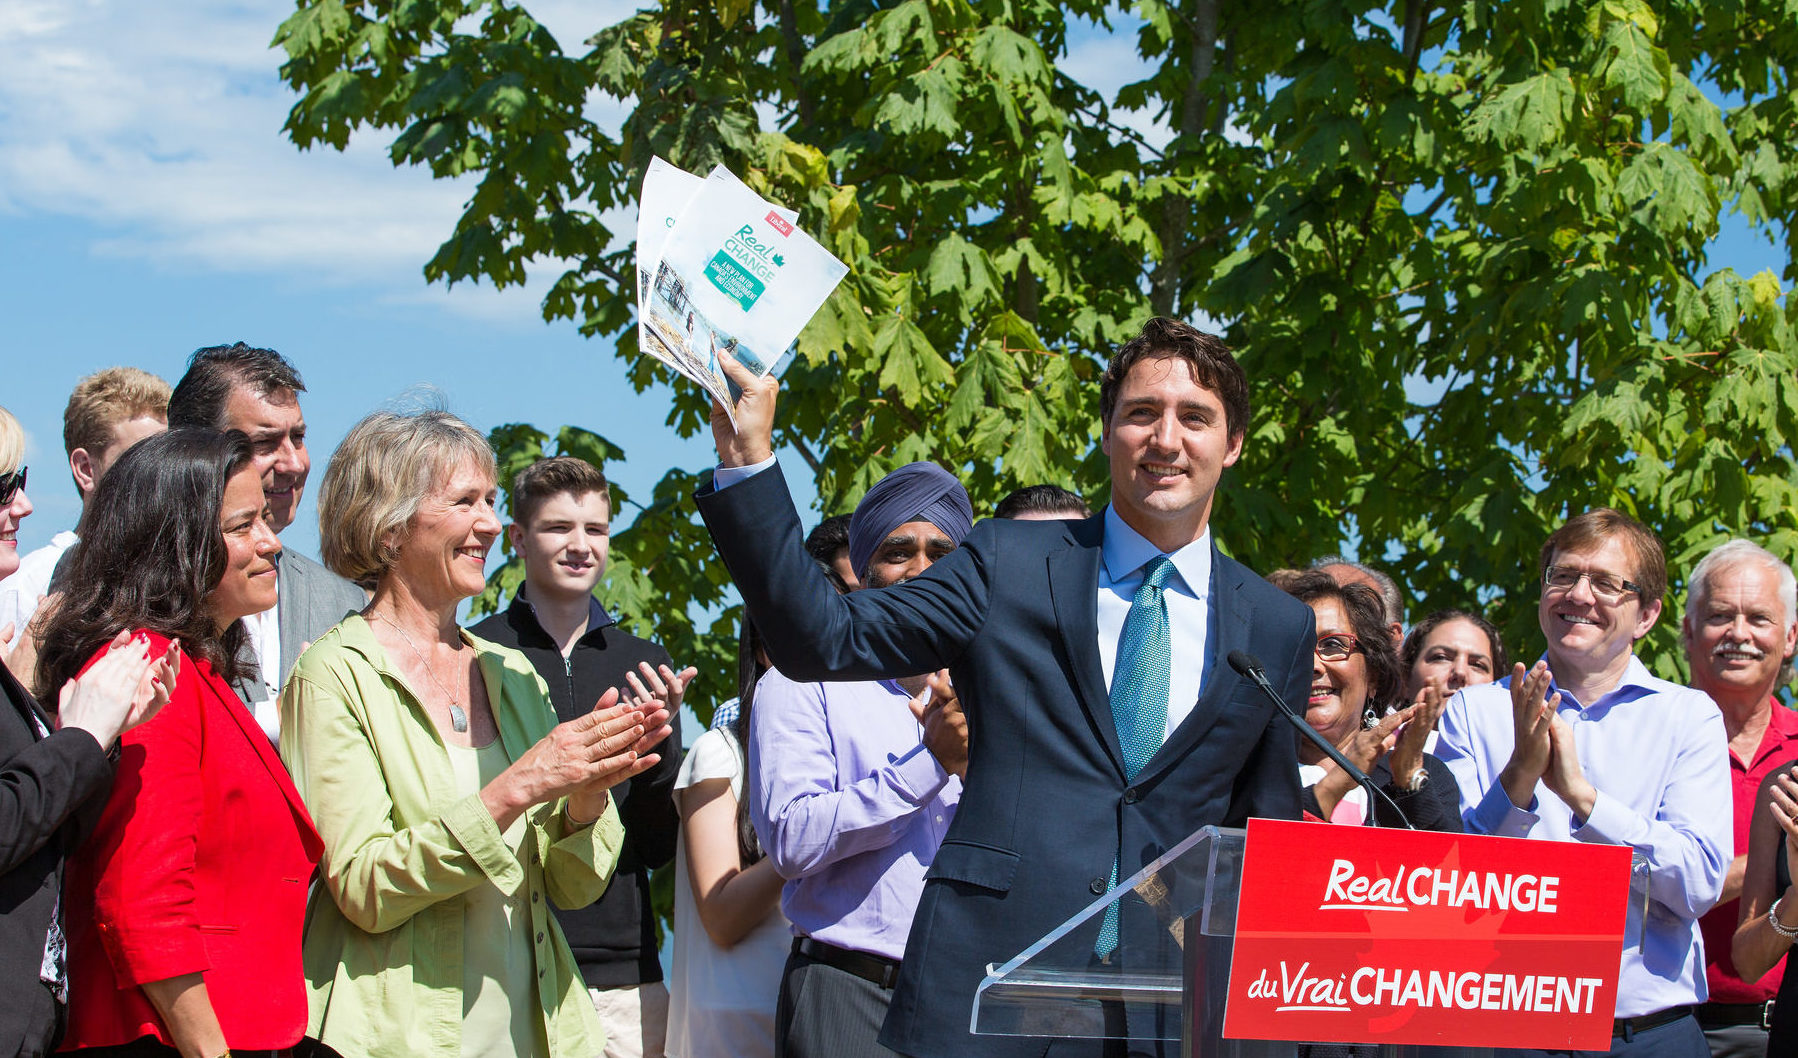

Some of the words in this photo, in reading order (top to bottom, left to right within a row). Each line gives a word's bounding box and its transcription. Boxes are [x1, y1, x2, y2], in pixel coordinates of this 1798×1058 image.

[734, 224, 775, 261] Real
[723, 262, 737, 276] NEW
[732, 269, 746, 284] PLAN
[742, 277, 755, 290] FOR
[724, 238, 775, 283] CHANGE
[714, 273, 726, 286] AND
